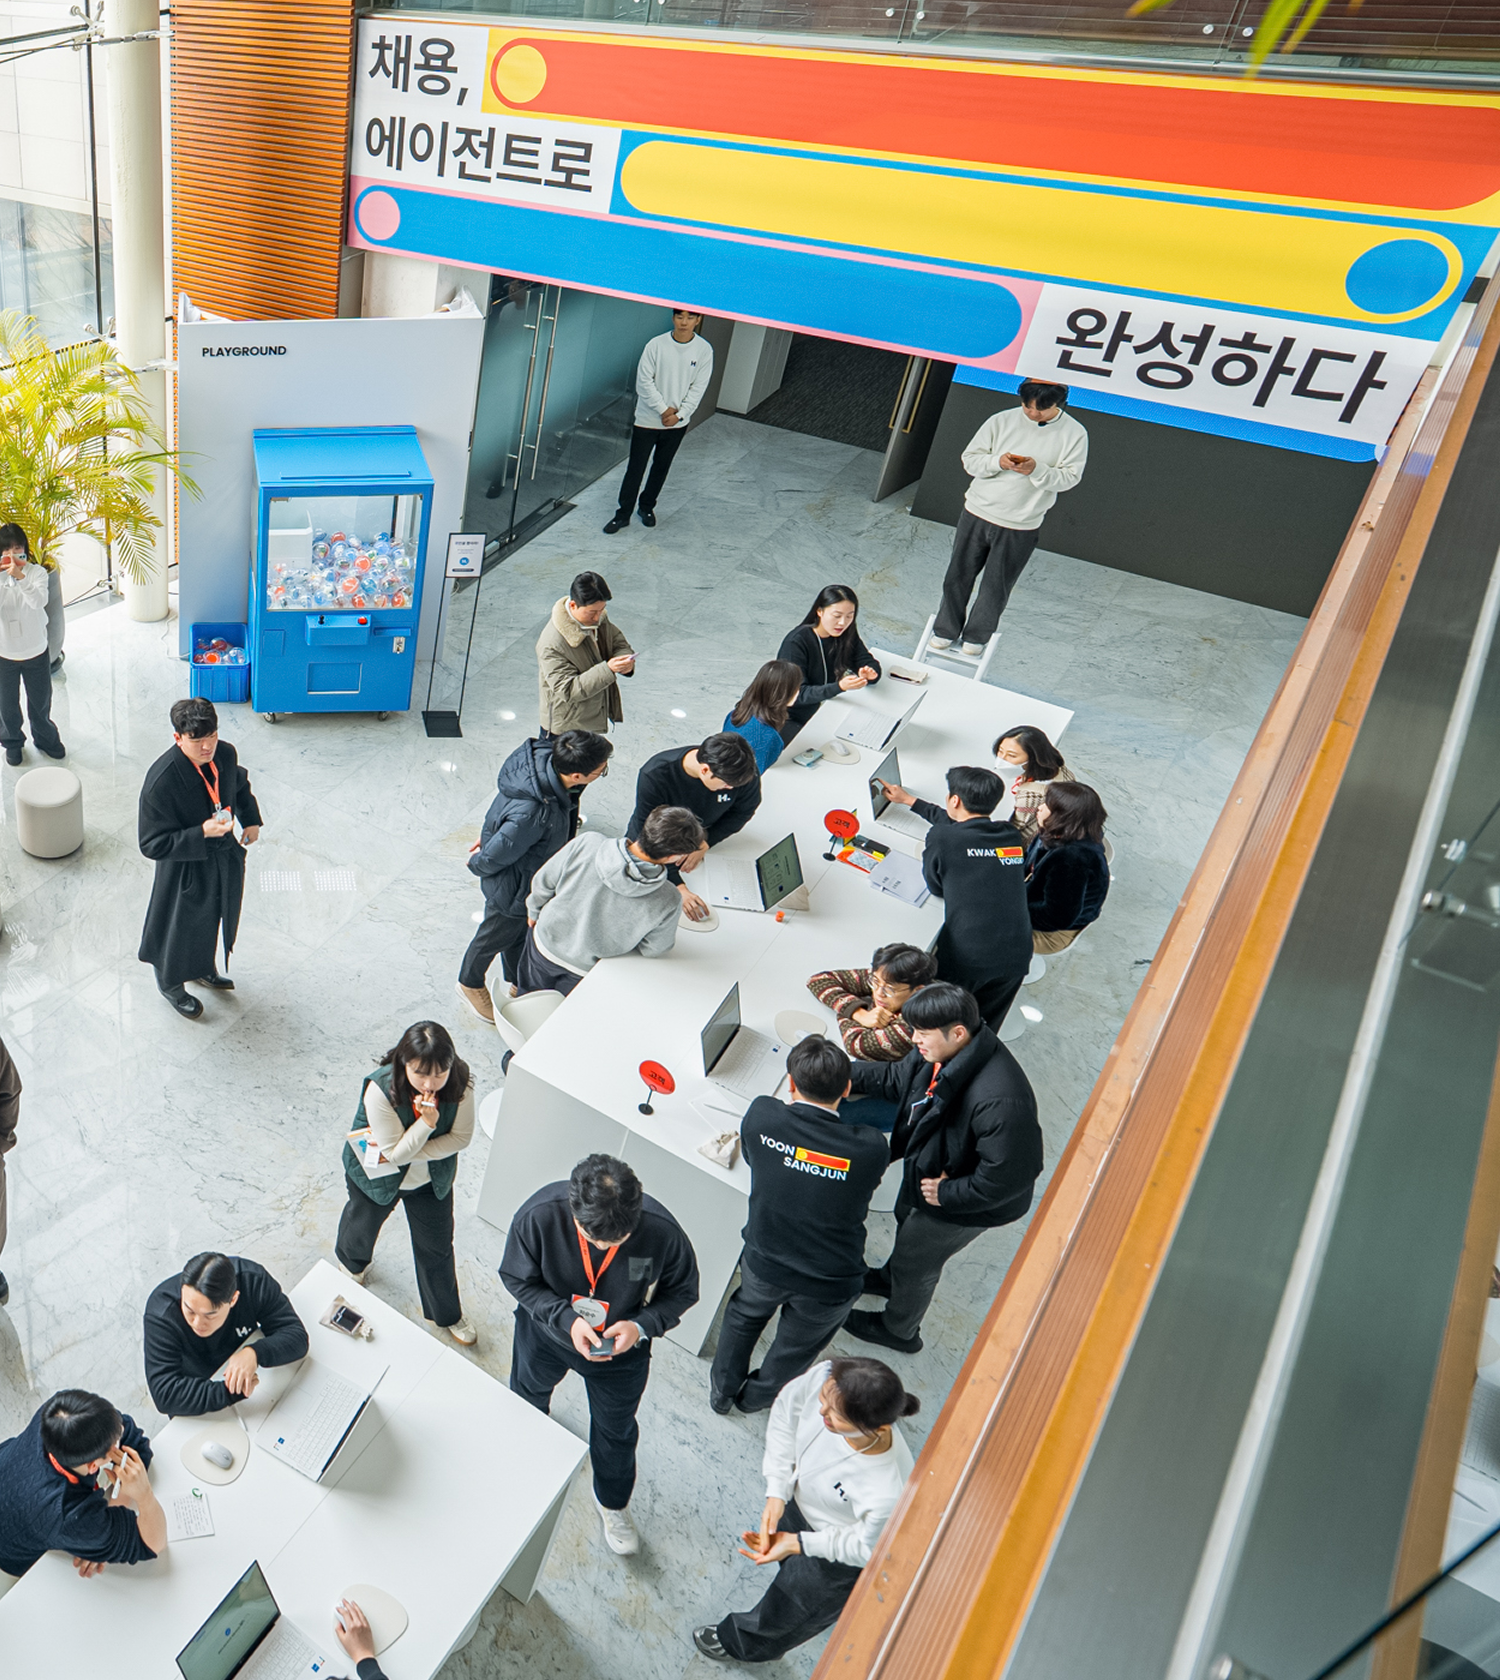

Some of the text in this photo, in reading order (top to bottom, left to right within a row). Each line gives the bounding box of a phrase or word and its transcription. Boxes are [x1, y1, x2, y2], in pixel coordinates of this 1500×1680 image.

[368, 35, 468, 106] 채용,
[365, 116, 593, 193] 에이전트로
[201, 345, 287, 357] PLAYGROUND
[1056, 308, 1388, 424] 완성하다
[966, 848, 997, 857] KWAK
[760, 1134, 795, 1156] YOON
[783, 1156, 847, 1181] SANGJUN
